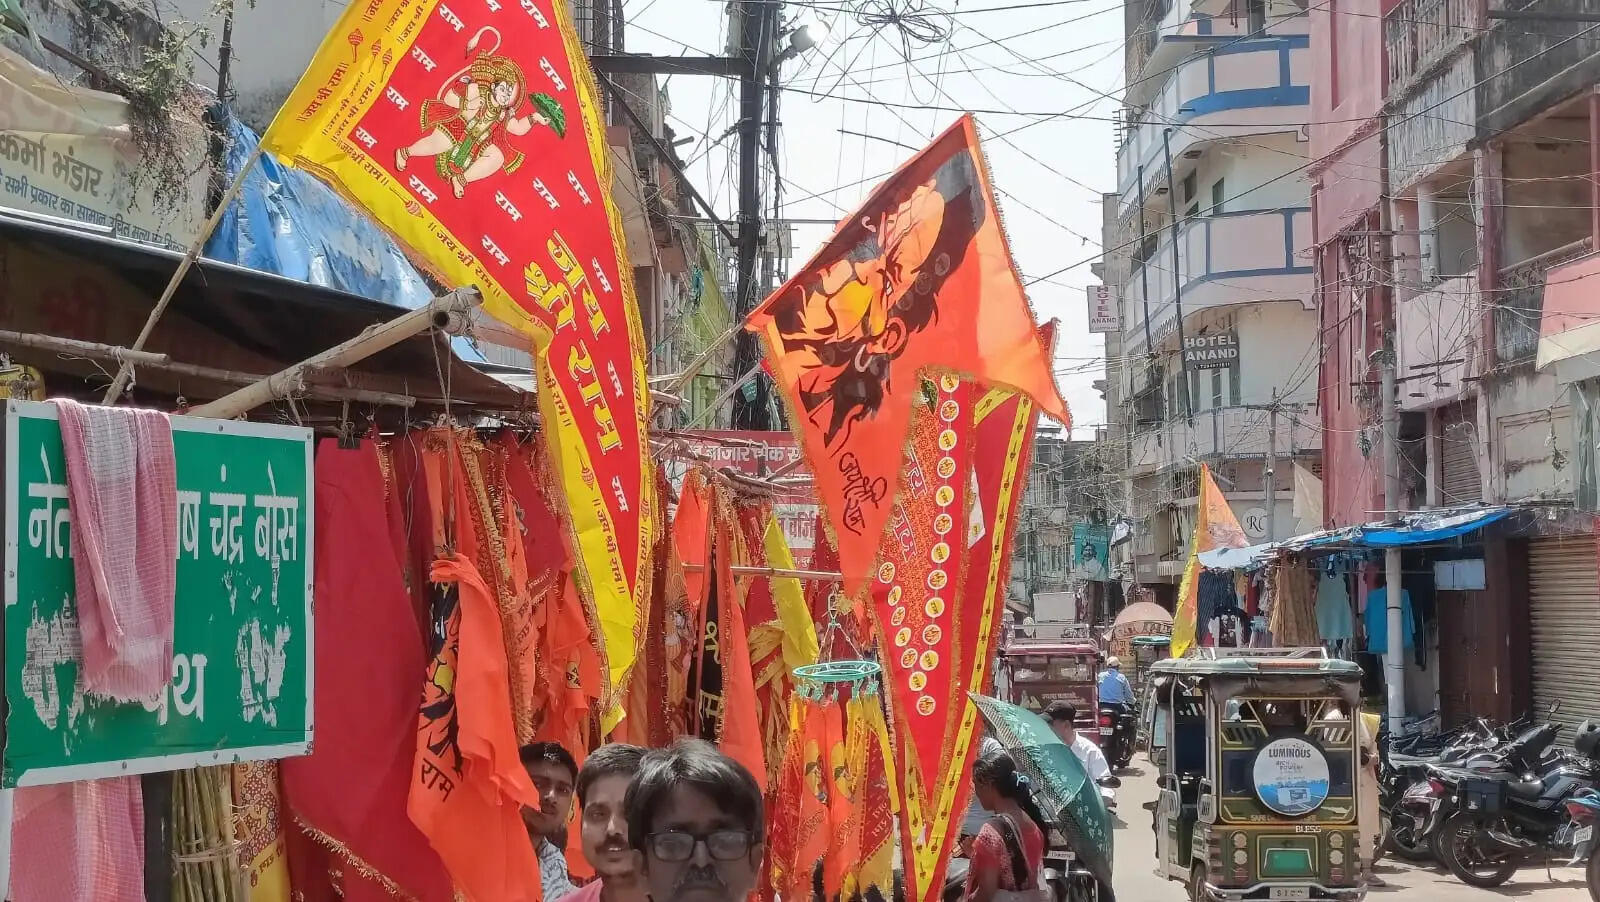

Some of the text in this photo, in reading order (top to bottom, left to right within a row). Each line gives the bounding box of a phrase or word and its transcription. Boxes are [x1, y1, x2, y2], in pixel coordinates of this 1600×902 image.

[438, 4, 465, 33] राम
[412, 44, 438, 73] राम
[539, 56, 567, 92] राम
[386, 86, 410, 112] राम
[355, 126, 378, 149] राम
[52, 145, 103, 197] भंडार
[567, 169, 592, 205] राम
[5, 174, 28, 198] सभी
[30, 185, 60, 212] प्रकार
[60, 197, 75, 217] का
[409, 174, 439, 205] राम
[495, 189, 523, 223] राम
[532, 176, 561, 211] राम
[482, 234, 511, 267] राम
[592, 257, 613, 293] राम
[523, 229, 623, 456] जय श्री राम
[1184, 335, 1237, 350] HOTEL
[1185, 348, 1238, 361] ANAND
[606, 359, 624, 399] राम
[611, 475, 630, 513] राम
[209, 463, 247, 565] चंद्र
[254, 459, 299, 562] बोस
[1268, 748, 1311, 759] LUMINOUS
[422, 757, 455, 803] राम
